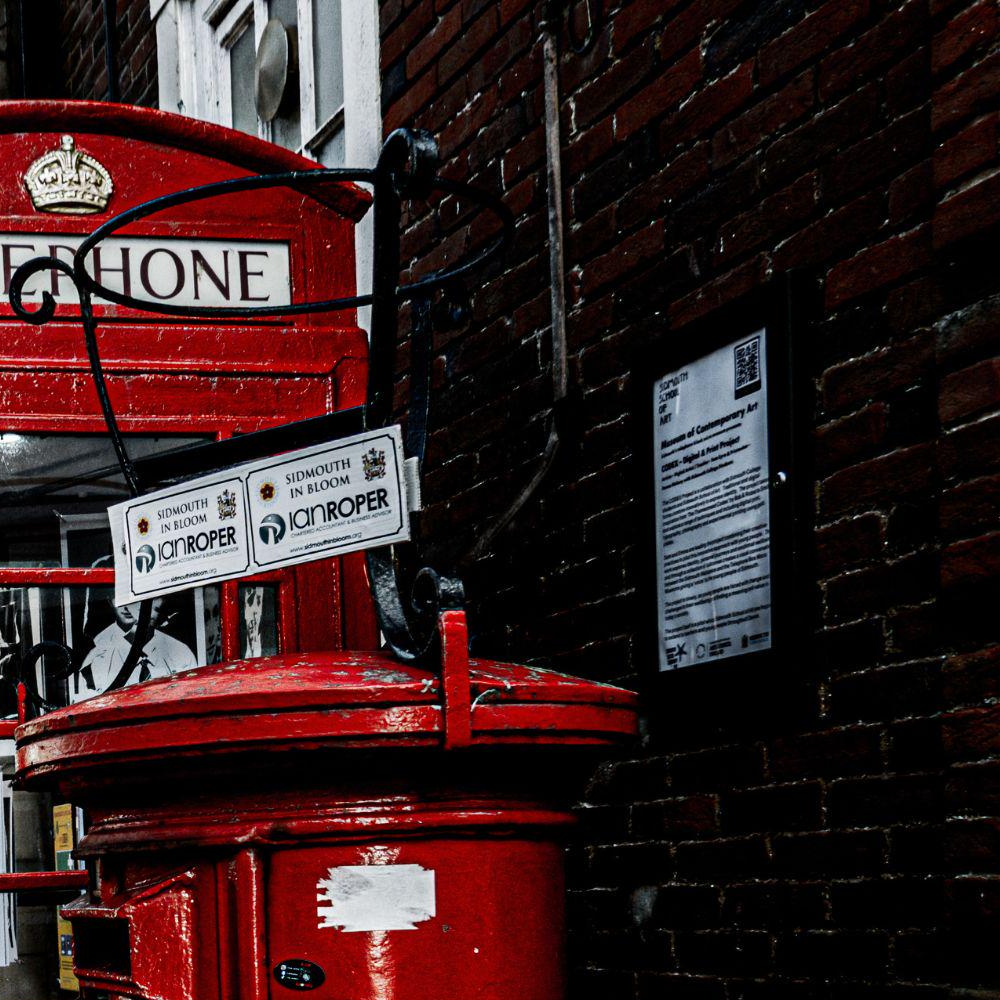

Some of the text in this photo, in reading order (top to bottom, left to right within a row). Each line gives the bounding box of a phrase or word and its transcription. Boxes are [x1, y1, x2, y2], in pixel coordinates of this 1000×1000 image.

[687, 427, 695, 439] of
[696, 409, 745, 435] Contemporary
[746, 402, 758, 414] Art
[286, 458, 351, 485] SIDMOUTH
[290, 475, 350, 499] IN BLOOM
[157, 498, 208, 520] SIDMOUTH
[161, 514, 208, 534] IN BLOOM
